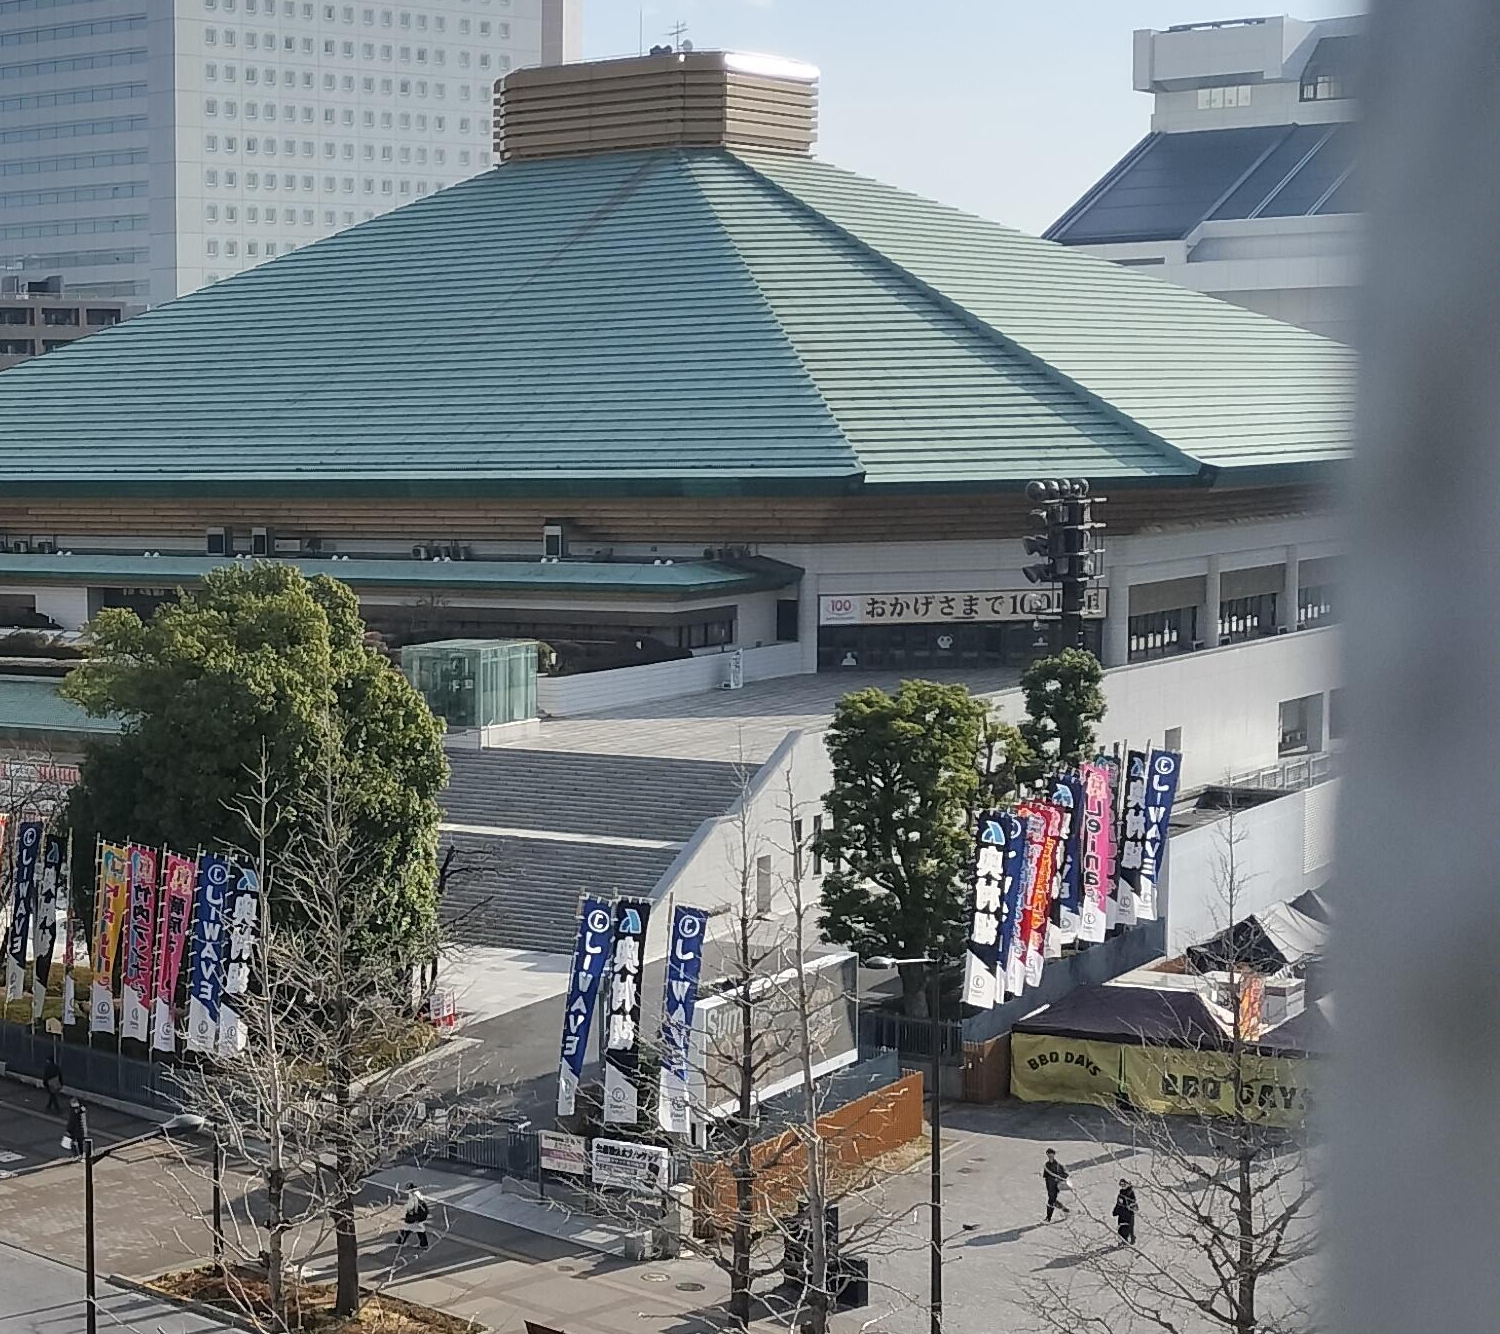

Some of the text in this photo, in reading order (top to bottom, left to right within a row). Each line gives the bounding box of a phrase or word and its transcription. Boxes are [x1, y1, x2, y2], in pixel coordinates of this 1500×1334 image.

[831, 599, 852, 613] 100
[1027, 1050, 1103, 1078] BBQ DAYS
